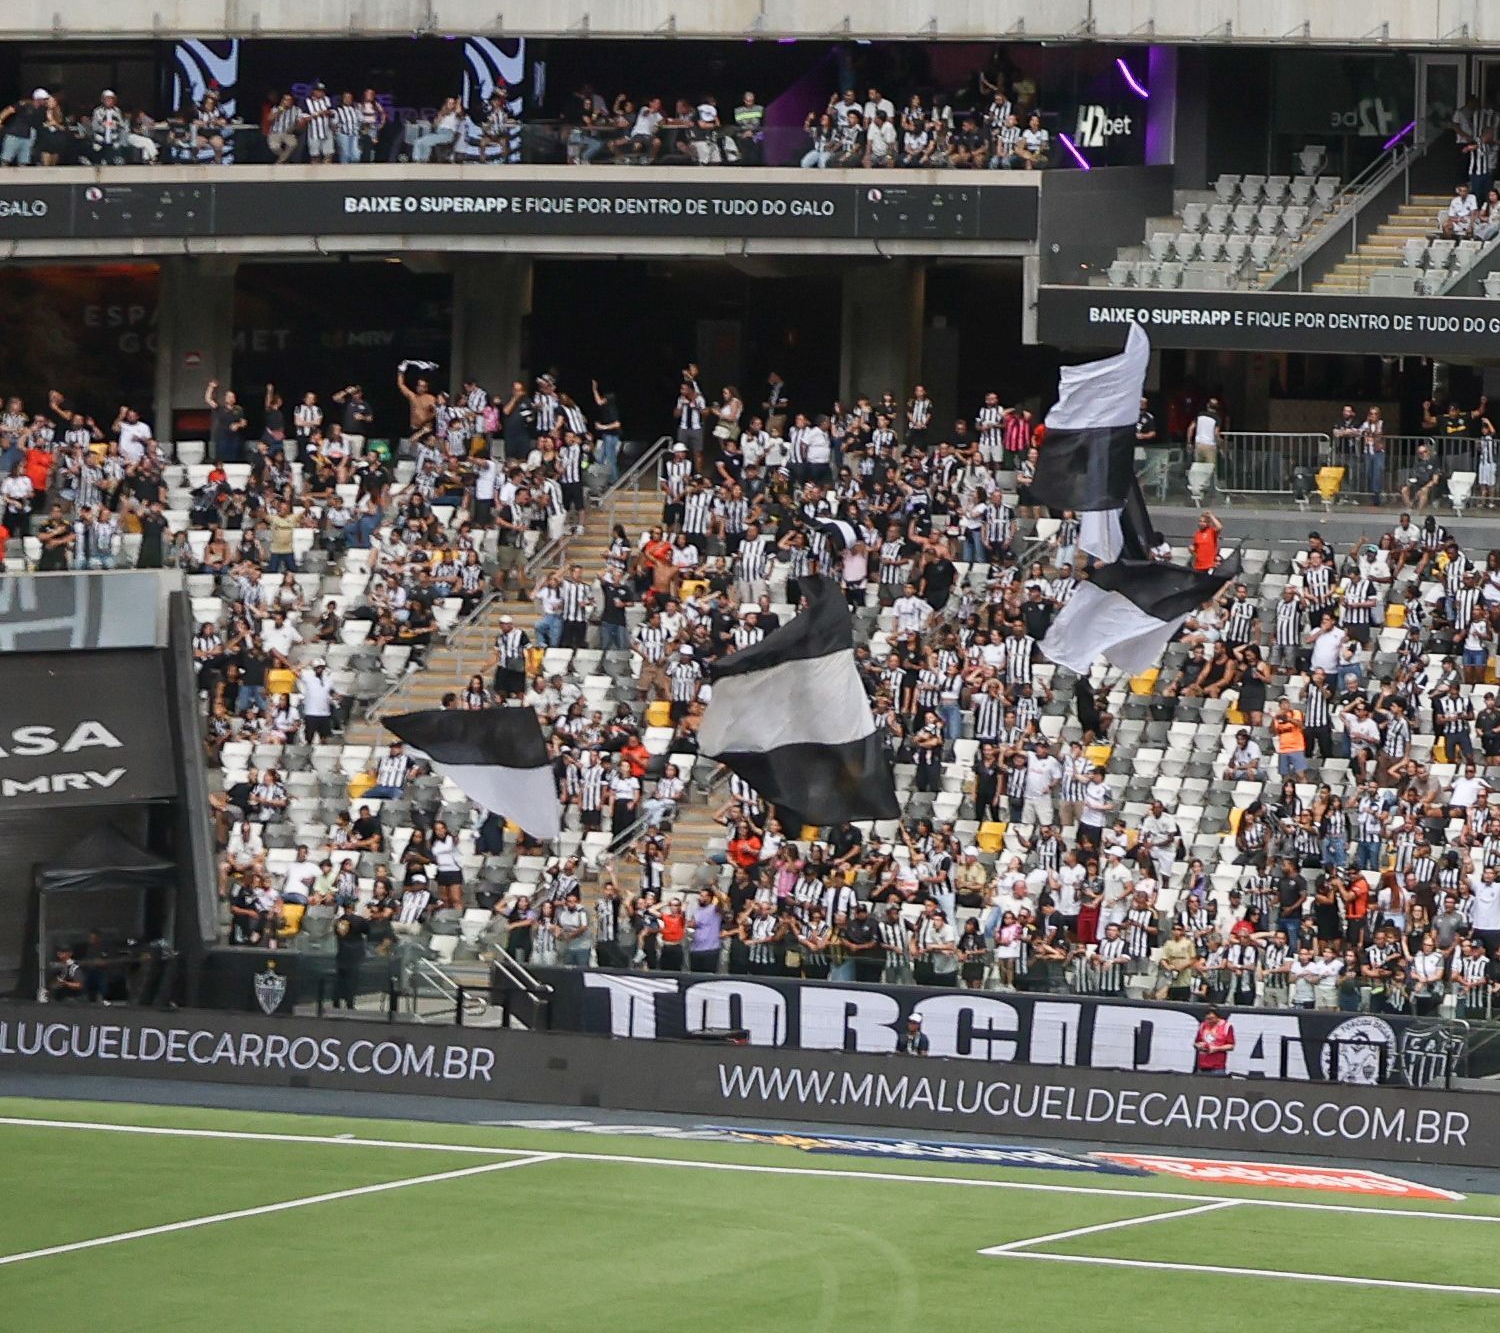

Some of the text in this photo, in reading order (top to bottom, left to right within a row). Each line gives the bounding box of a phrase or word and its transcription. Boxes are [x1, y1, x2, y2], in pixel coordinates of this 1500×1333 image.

[1074, 104, 1132, 148] H2bet
[344, 196, 835, 216] BAIXE O SUPERAPP E FIQUE POR DENTRO DE TUDO DO GALO
[1089, 307, 1137, 325] BAIXE
[1136, 308, 1151, 324] O
[1151, 308, 1232, 326] SUPERAPP
[1234, 310, 1244, 326] E
[1246, 311, 1292, 328] FIQUE
[1294, 312, 1326, 329] POR
[1328, 313, 1390, 330] DENTRO
[1393, 314, 1414, 331] DE
[1416, 315, 1460, 332] TUDO
[1462, 316, 1486, 333] DO
[0, 720, 124, 759] SA
[1, 766, 128, 798] MRV
[584, 973, 1311, 1079] TORCIDA
[718, 1063, 1471, 1148] WWW.MMALUGUELDECARROS.COM.BR
